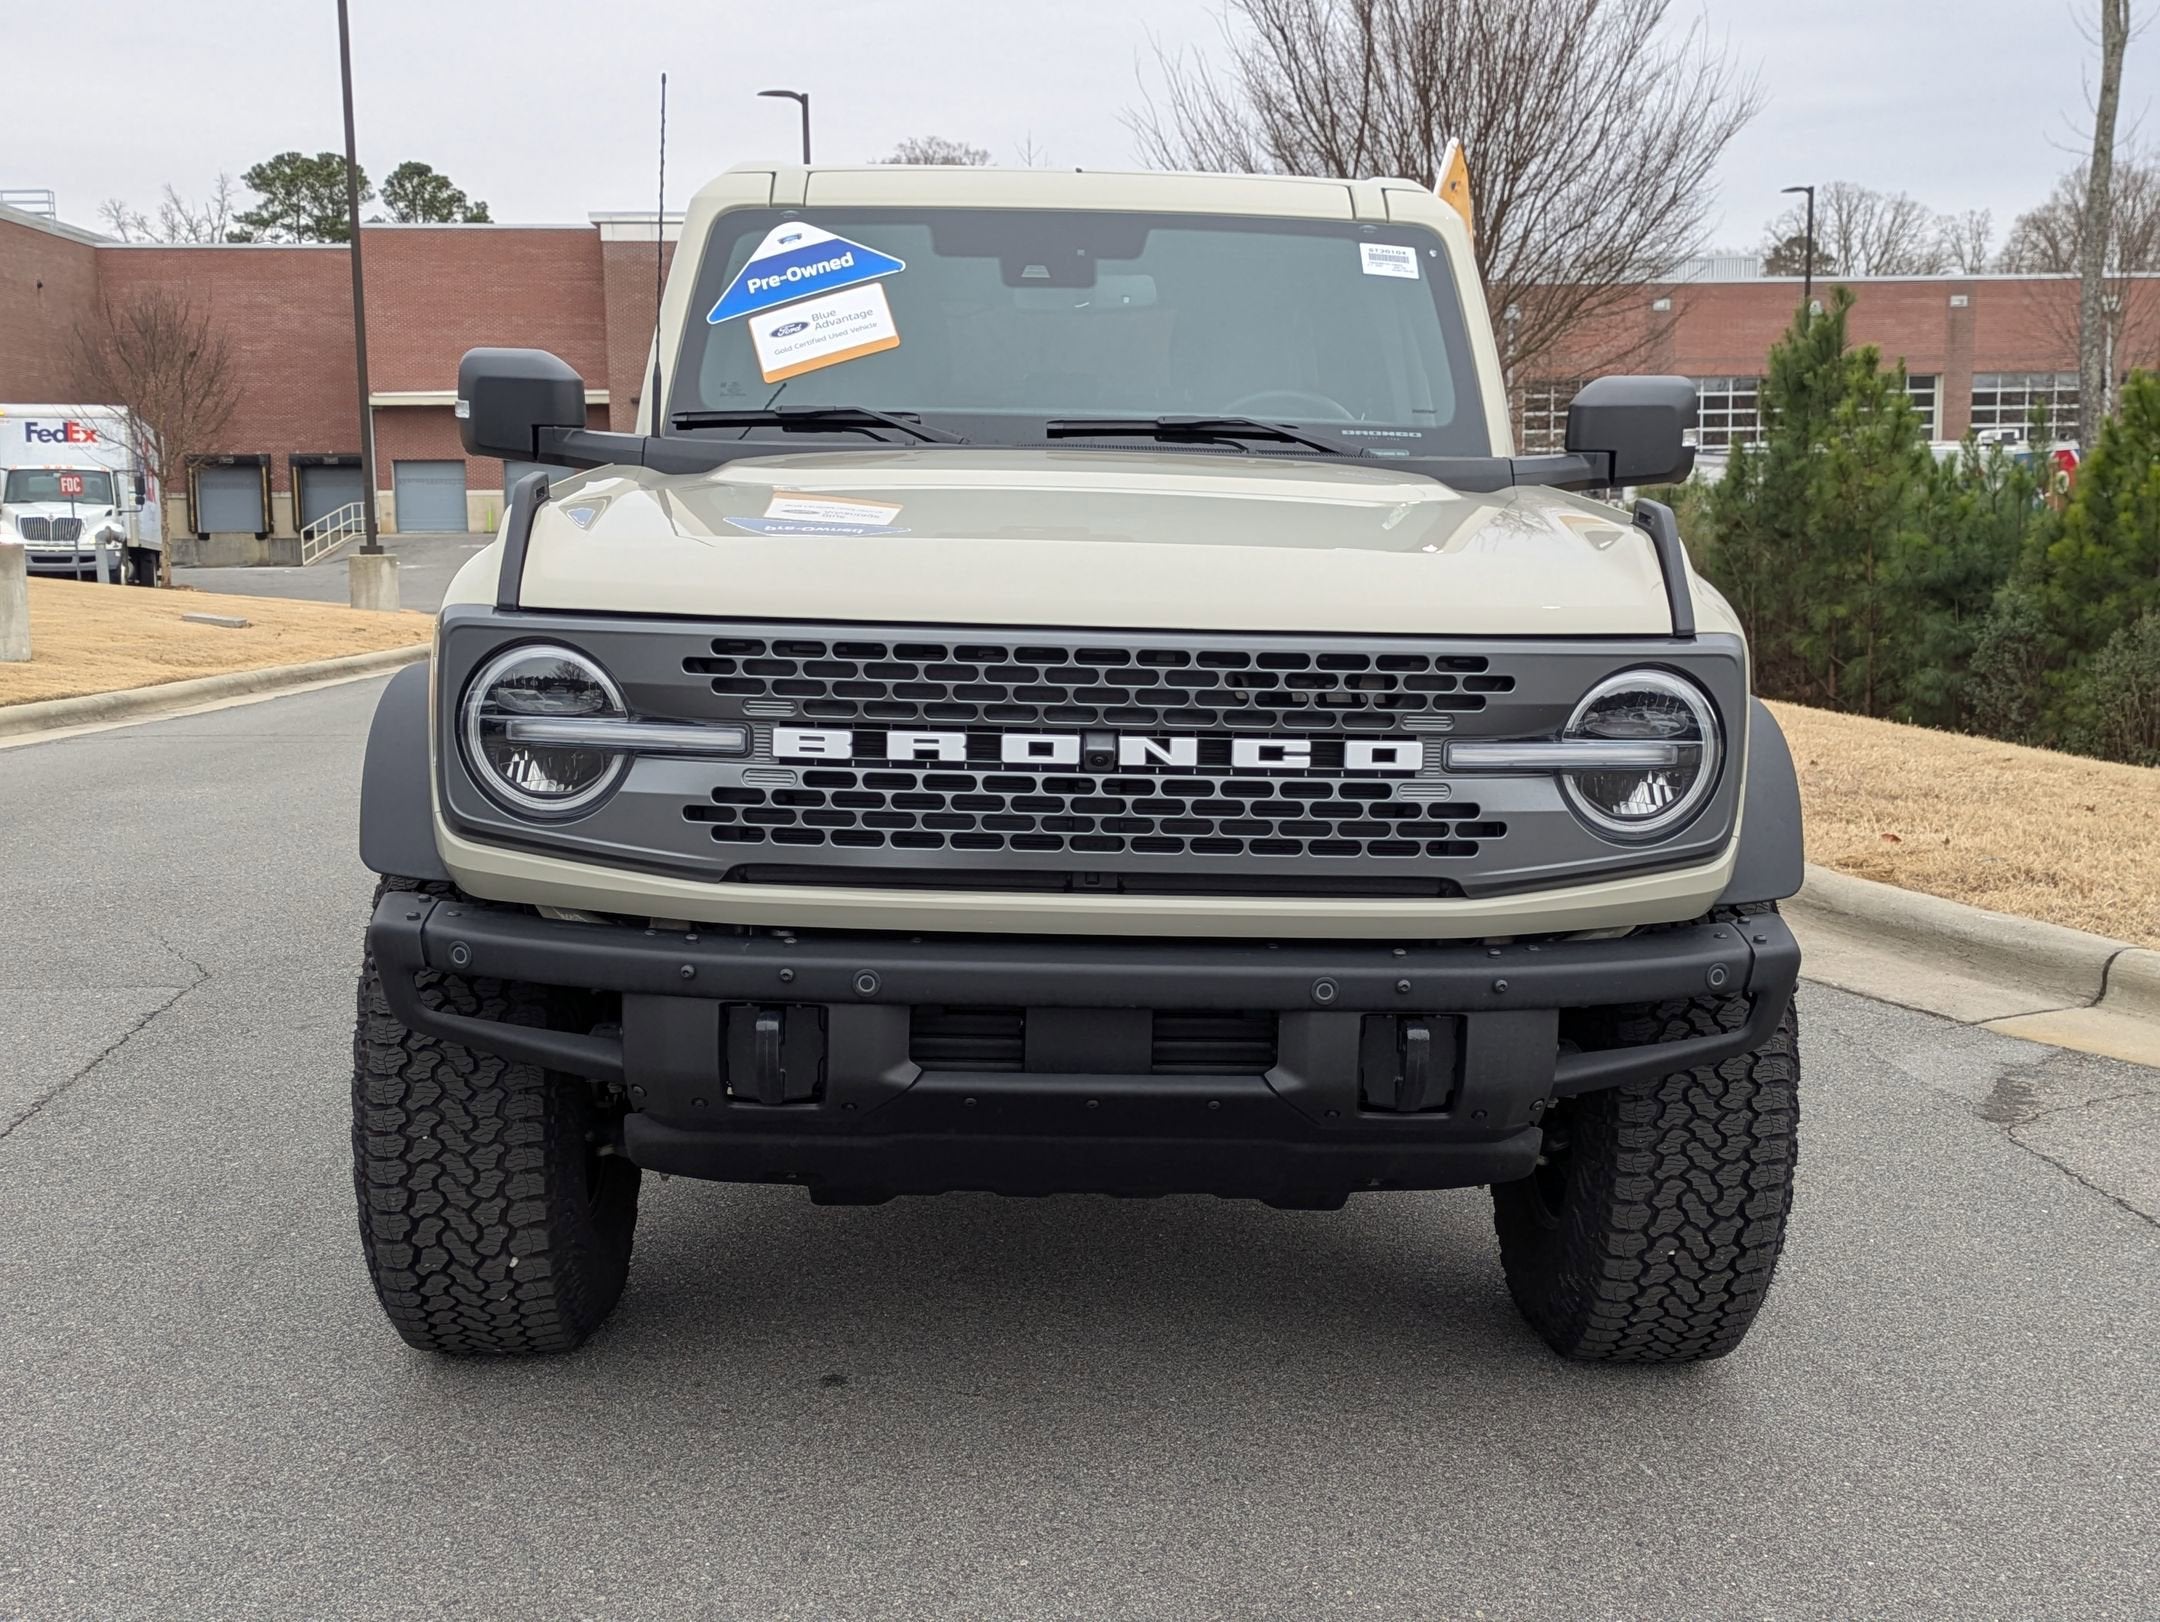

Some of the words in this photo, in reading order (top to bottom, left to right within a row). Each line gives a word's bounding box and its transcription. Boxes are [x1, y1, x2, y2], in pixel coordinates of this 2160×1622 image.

[747, 252, 855, 294] Pre-Owned
[811, 309, 837, 322] Blue
[814, 309, 874, 330] Advantage
[774, 345, 793, 355] Gold
[794, 335, 827, 349] Certified
[828, 329, 849, 341] Used
[850, 321, 878, 334] Vehicle
[24, 421, 98, 443] FedEx
[60, 476, 81, 492] FDC
[772, 727, 1424, 770] BRONCO
